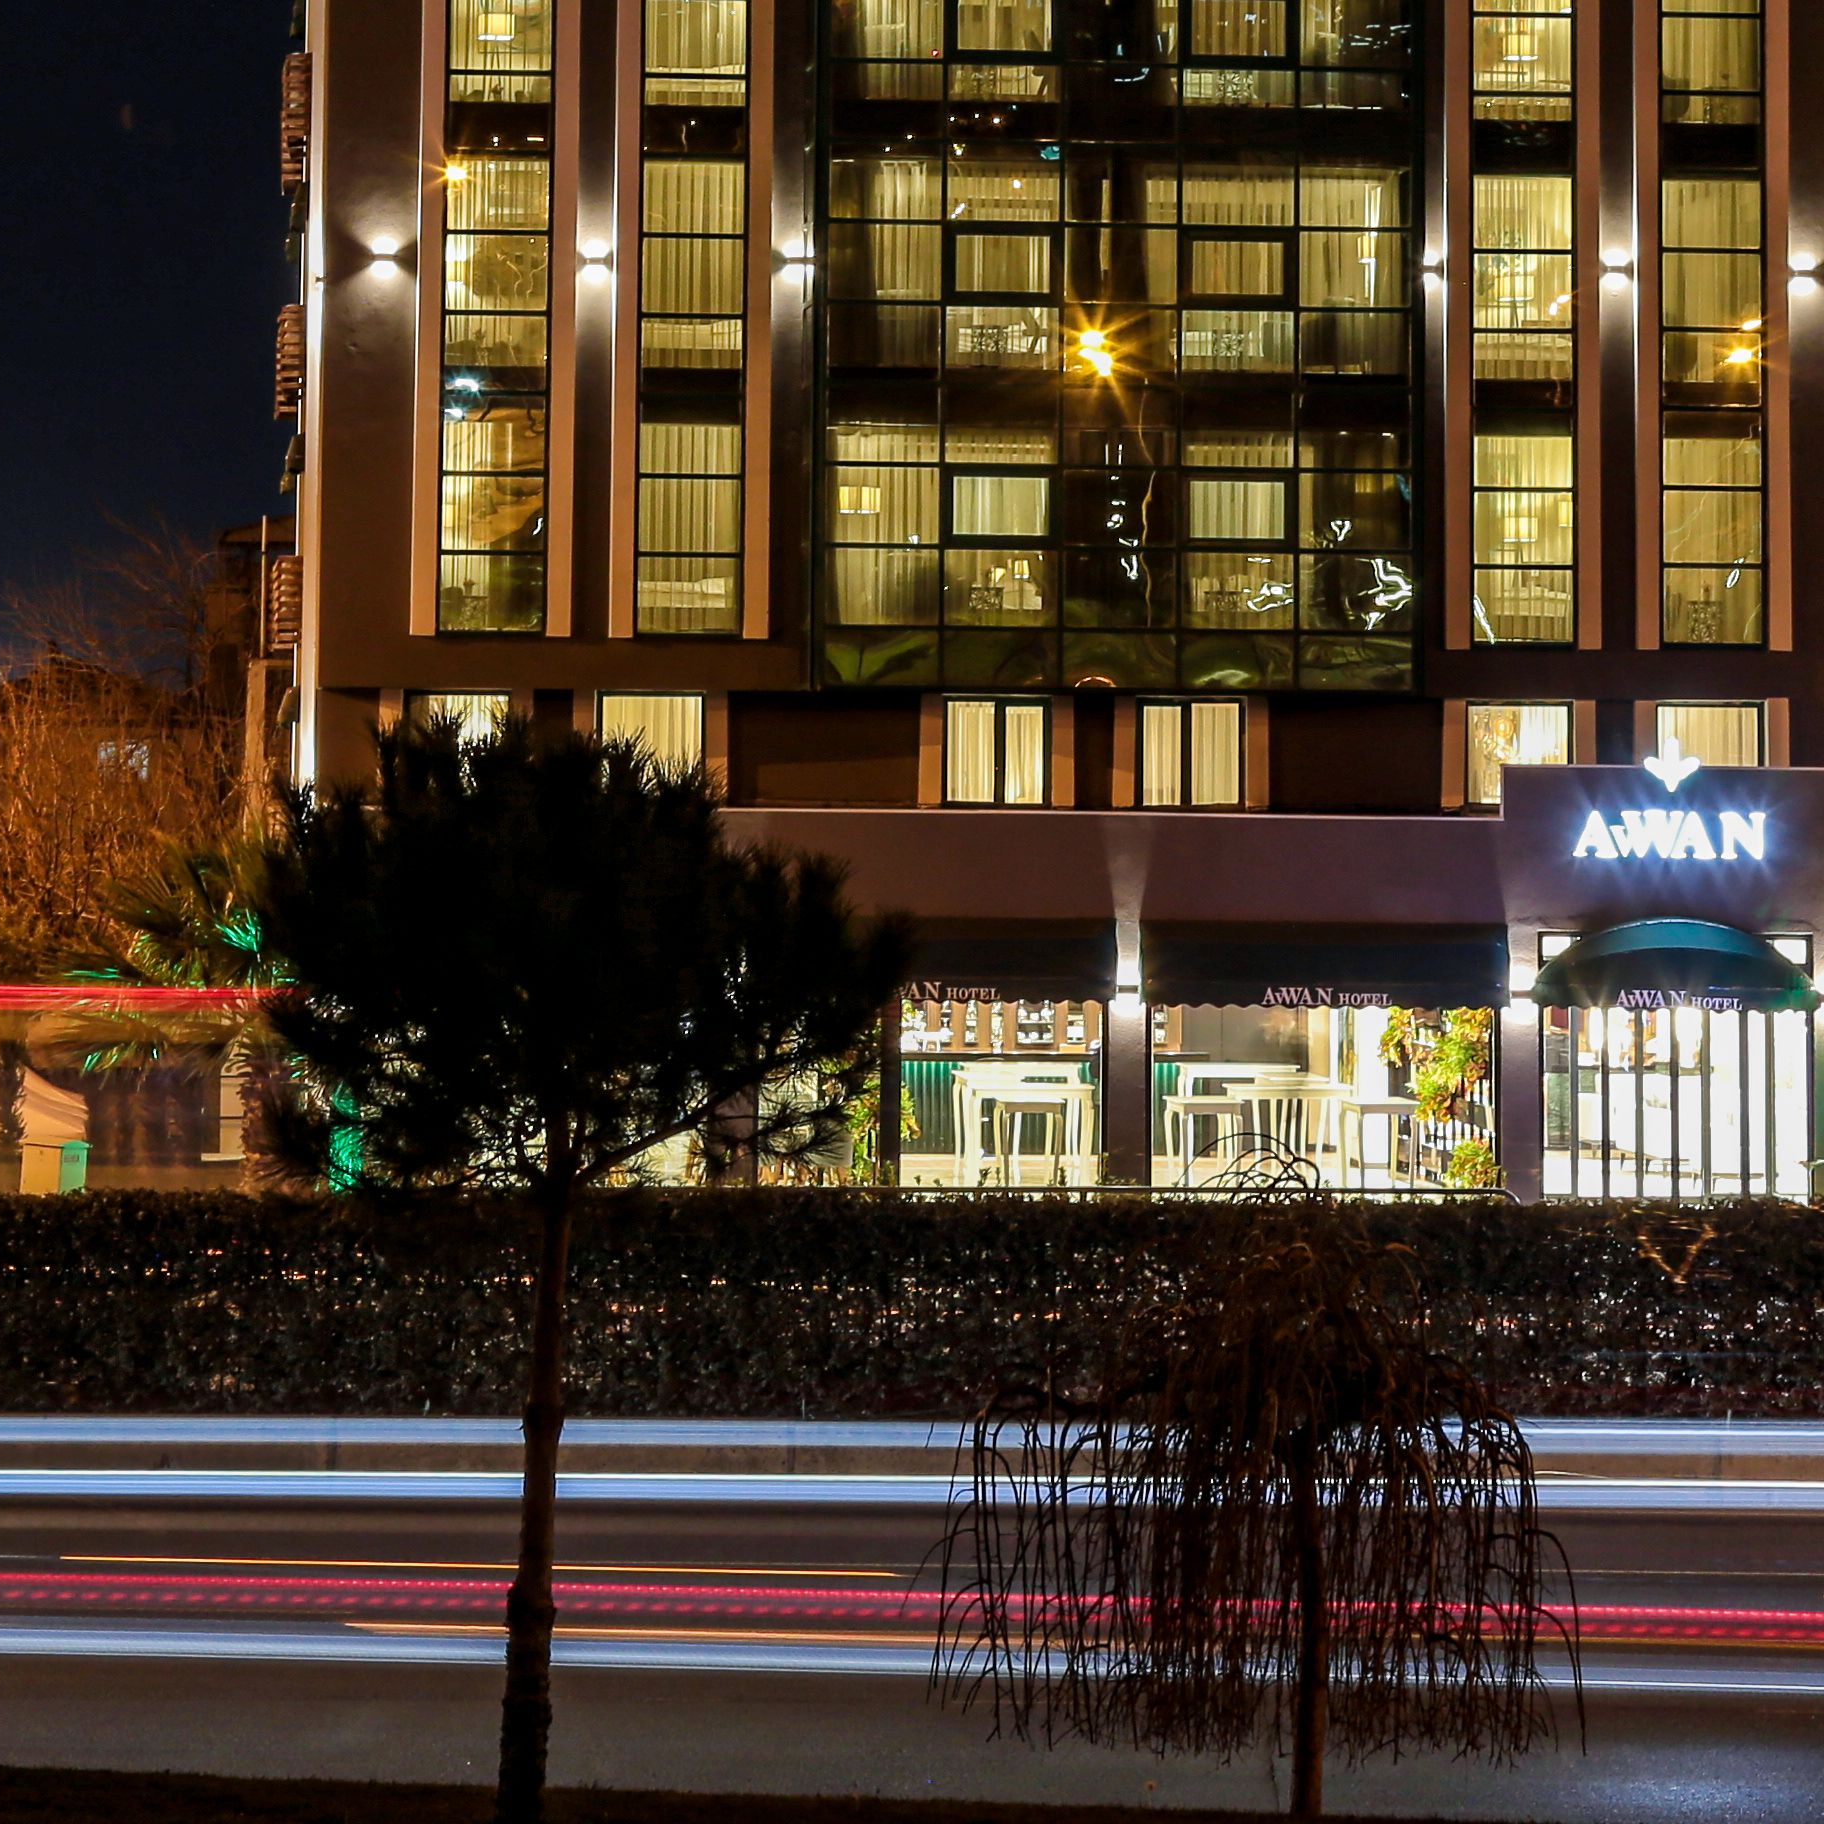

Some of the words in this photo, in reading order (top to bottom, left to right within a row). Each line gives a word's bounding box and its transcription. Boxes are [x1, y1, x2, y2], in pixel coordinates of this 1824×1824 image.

[946, 987, 1001, 1000] HOTEL
[1338, 993, 1393, 1006] HOTEL
[1691, 996, 1743, 1011] HOTEL
